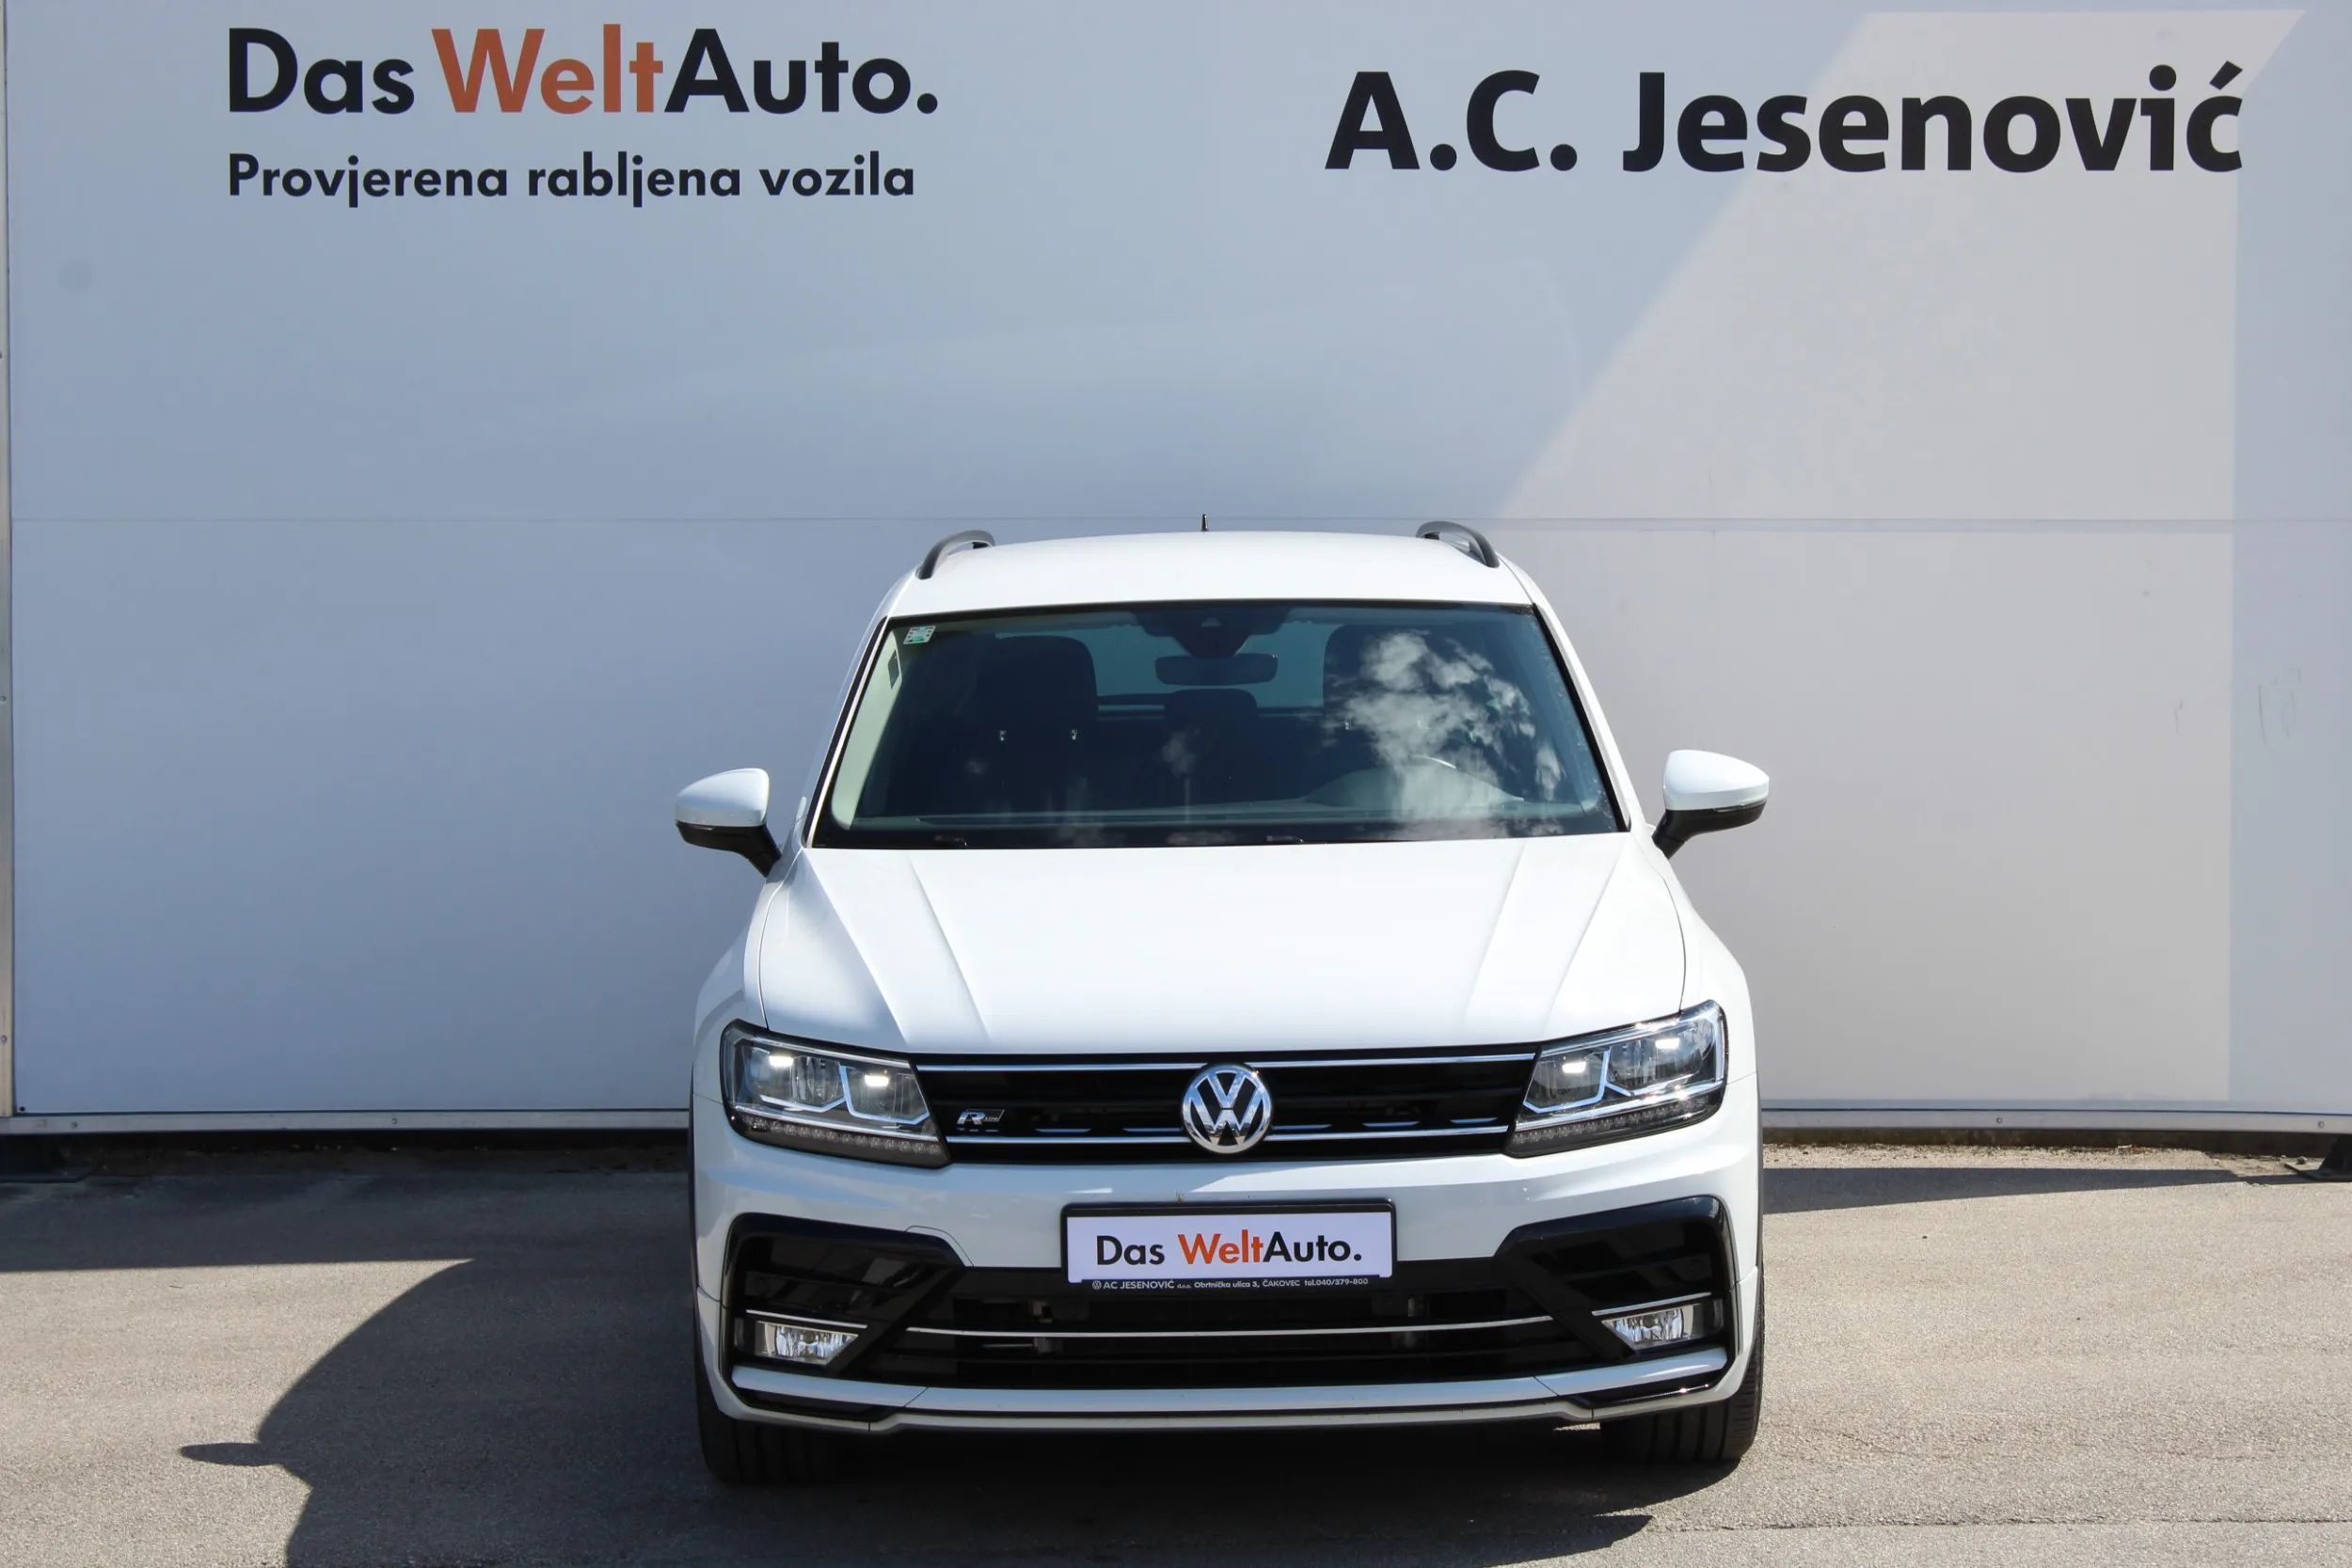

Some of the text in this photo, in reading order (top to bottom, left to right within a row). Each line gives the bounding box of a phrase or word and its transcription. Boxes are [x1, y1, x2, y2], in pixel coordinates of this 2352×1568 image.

[229, 23, 939, 115] Das WeltAuto.
[1325, 61, 2244, 173] A.C. Jesenović
[229, 150, 915, 208] Provjerena rabljena vozila
[1096, 1228, 1362, 1266] Das WeltAuto.
[1103, 1280, 1119, 1290] AC
[1120, 1279, 1175, 1290] JESENOVIĆ
[1232, 1280, 1250, 1289] ulica
[1262, 1278, 1301, 1288] ČAKOVEC
